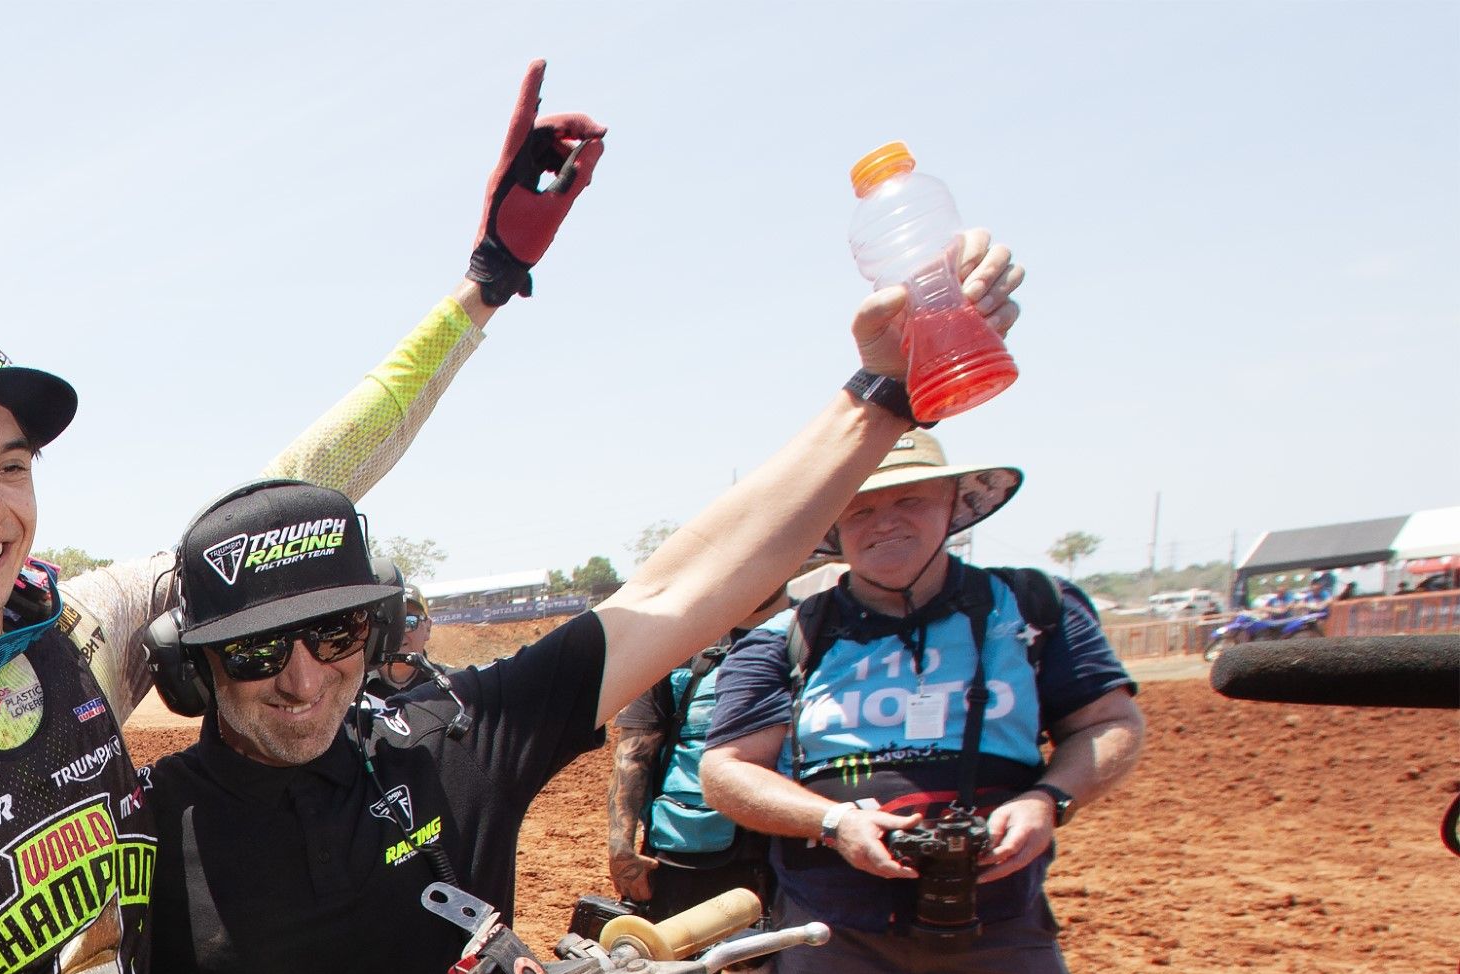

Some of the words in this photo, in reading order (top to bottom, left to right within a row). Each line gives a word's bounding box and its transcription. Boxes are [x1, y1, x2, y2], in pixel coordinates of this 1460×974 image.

[209, 541, 241, 557] TRIUMPH
[244, 533, 344, 568] RACING
[249, 518, 346, 553] TRIUMPH
[255, 555, 308, 574] FACTORY
[307, 548, 335, 560] TEAM
[852, 648, 940, 681] 110
[800, 680, 1015, 733] HOTO
[51, 741, 113, 788] TRIUMPH
[21, 811, 113, 887] WORLD
